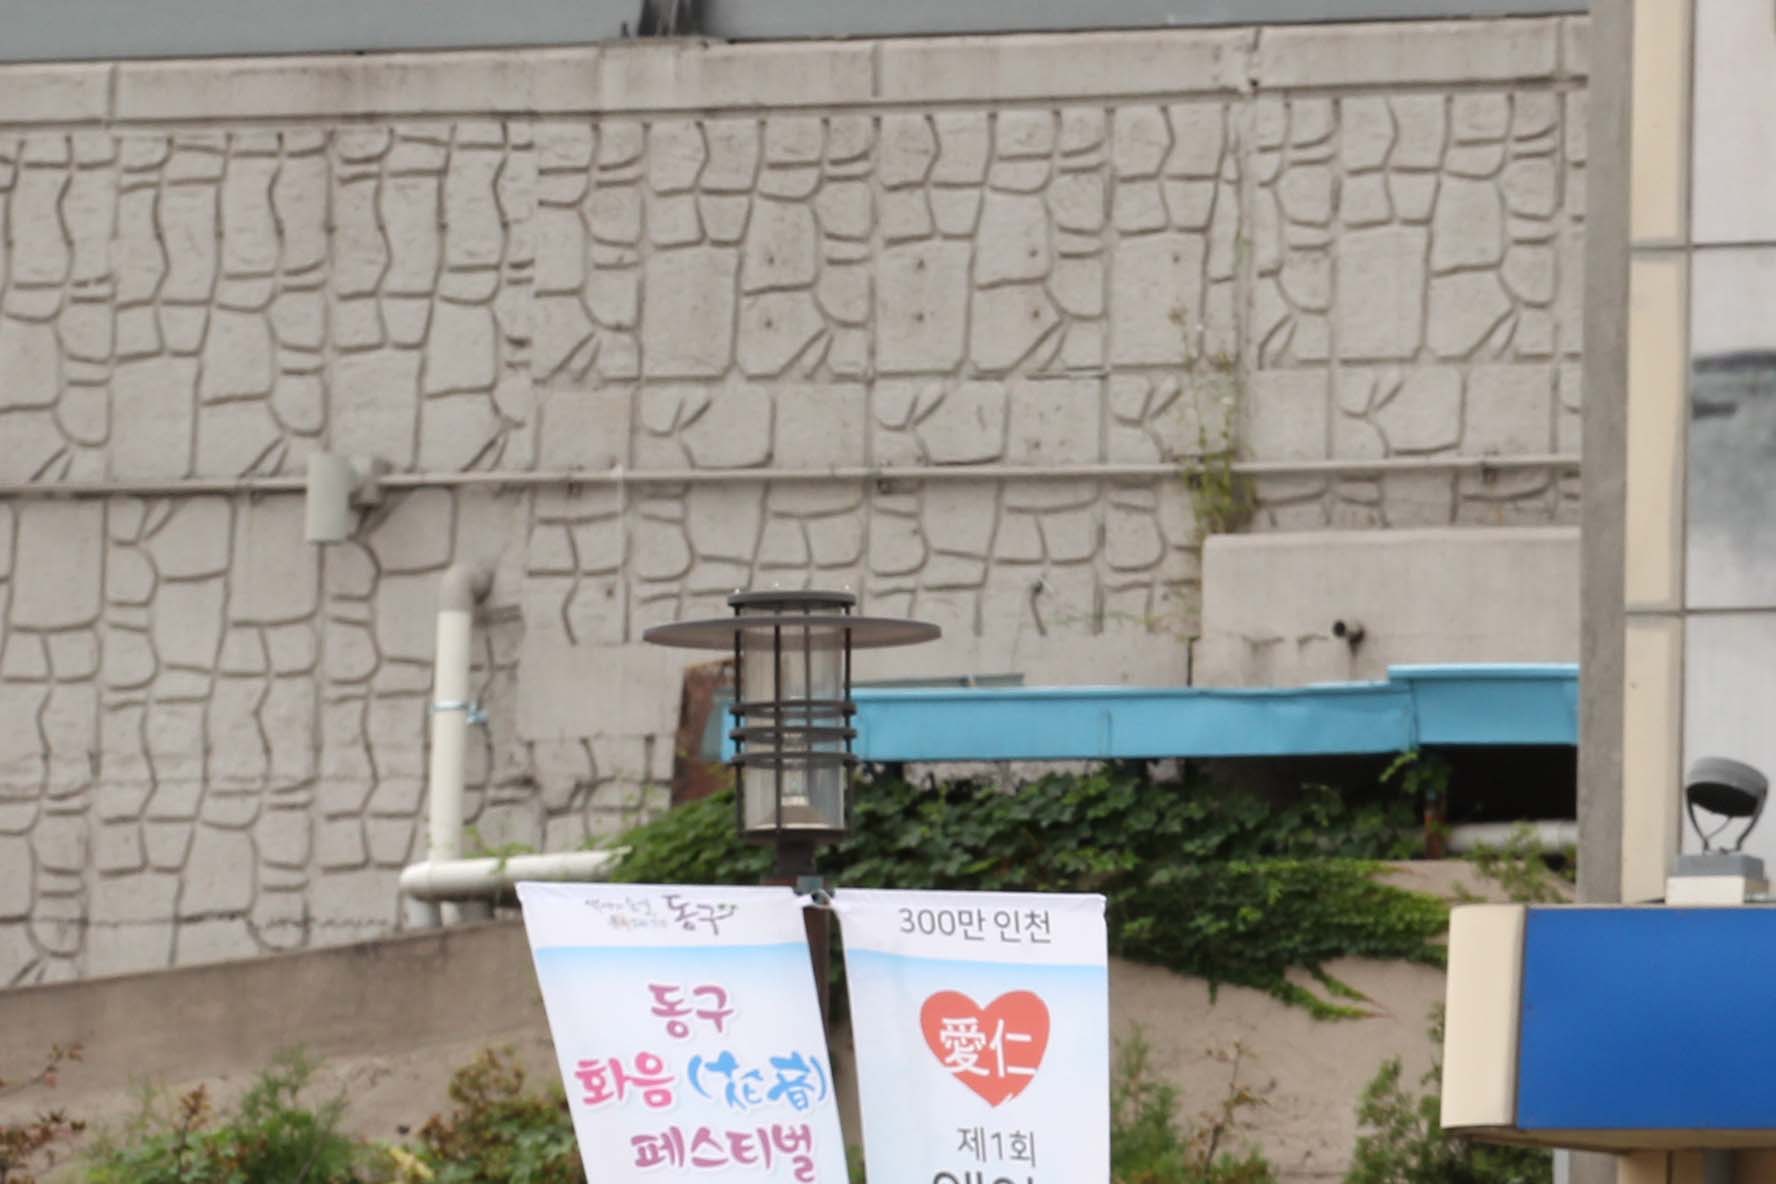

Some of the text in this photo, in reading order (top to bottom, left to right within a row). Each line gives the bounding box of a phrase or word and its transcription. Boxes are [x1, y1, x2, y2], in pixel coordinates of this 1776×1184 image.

[900, 908, 1052, 944] 300만 인천
[648, 984, 734, 1038] 동구
[939, 1016, 1039, 1078] 愛仁
[575, 1051, 675, 1108] 화음
[631, 1124, 815, 1183] 페스티벌
[957, 1127, 1037, 1167] 제1회
